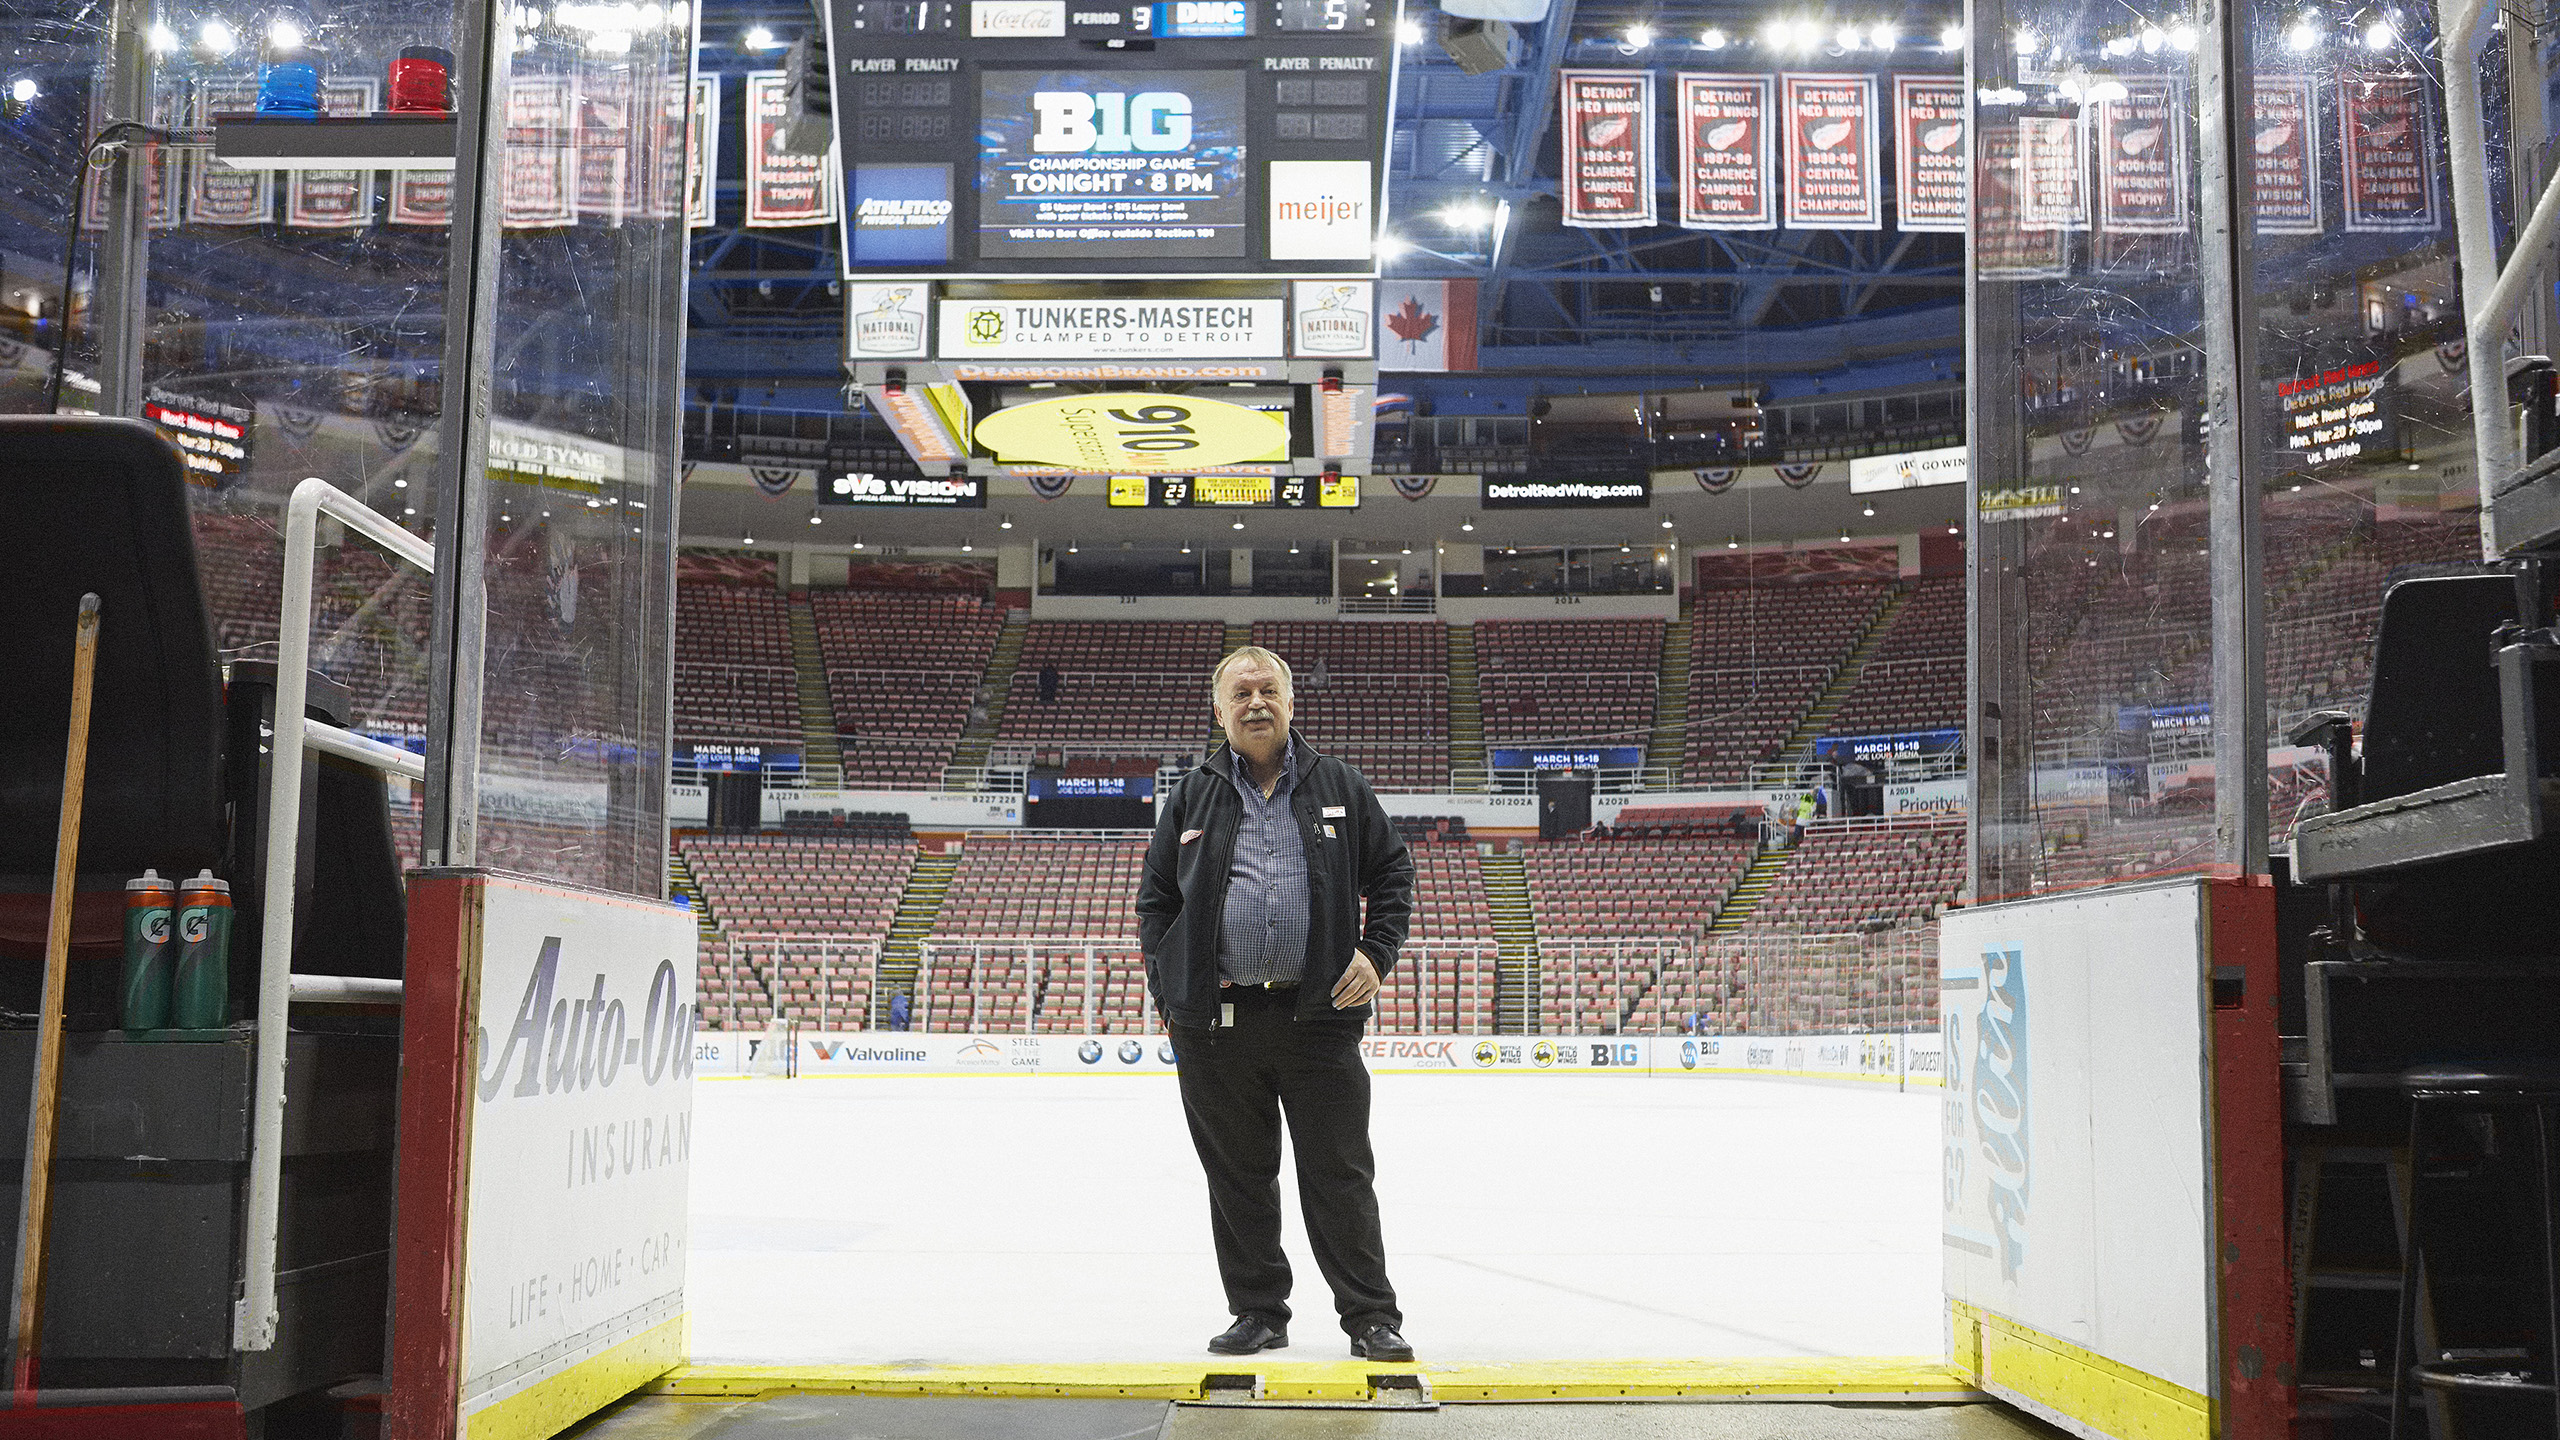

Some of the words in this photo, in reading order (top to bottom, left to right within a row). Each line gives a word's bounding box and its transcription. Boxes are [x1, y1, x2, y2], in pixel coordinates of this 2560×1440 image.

[1073, 12, 1120, 25] PERIOD
[1135, 7, 1150, 31] 3
[1177, 2, 1244, 24] DMC
[1326, 0, 1345, 30] 5
[851, 58, 896, 72] PLAYER
[905, 58, 959, 72] PENALTY
[1264, 57, 1309, 70] PLAYER
[1320, 57, 1374, 70] PENALTY
[1581, 87, 1635, 98] DETROIT
[1699, 91, 1752, 103] DETROIT
[1804, 90, 1857, 103] DETROIT
[1605, 101, 1641, 113] WINGS
[1694, 105, 1719, 118] RED
[1722, 105, 1759, 118] WINGS
[1799, 105, 1823, 117] RED
[1826, 105, 1863, 118] WINGS
[1911, 107, 1936, 119] RED
[1029, 158, 1147, 171] CHAMPIONSHIP
[1149, 158, 1196, 171] GAME
[1582, 166, 1637, 177] CLARENCE
[1697, 168, 1757, 180] CLARENCE
[1805, 168, 1858, 181] CENTRAL
[1011, 173, 1128, 192] TONIGHT
[1150, 173, 1168, 192] 8
[1175, 173, 1213, 192] PM
[1582, 181, 1636, 193] CAMPBELL
[770, 188, 814, 200] TROPHY
[1698, 183, 1757, 196] CAMPBELL
[1805, 184, 1860, 196] DIVISION
[1595, 197, 1624, 208] BOWL
[1711, 199, 1744, 211] BOWL
[2121, 192, 2164, 205] TROPHY
[1053, 203, 1082, 213] Upper
[1083, 203, 1107, 211] Bowl
[1132, 203, 1160, 211] Lower
[1161, 202, 1185, 211] Bowl
[1278, 194, 1364, 227] meijer
[1799, 199, 1867, 212] CHAMPIONS
[1058, 213, 1080, 221] your
[1125, 213, 1161, 221] today's
[1161, 213, 1188, 221] game
[1009, 229, 1034, 238] Visit
[1036, 229, 1054, 238] the
[1056, 229, 1078, 238] Box
[1079, 229, 1111, 239] Office
[1112, 229, 1153, 238] outside
[1154, 229, 1196, 238] Section
[1196, 229, 1215, 238] 101
[1016, 307, 1253, 328] TUNKERS-MASTECH
[863, 321, 915, 334] NATIONAL
[1308, 320, 1360, 333] NATIONAL
[1016, 332, 1112, 342] CLAMPED
[1127, 332, 1150, 342] TO
[1164, 332, 1253, 342] DETROIT
[2284, 388, 2327, 411] Detroit
[2329, 382, 2351, 400] Red
[2295, 411, 2319, 429] Next
[2321, 408, 2347, 423] Home
[2349, 401, 2375, 417] Game
[2290, 434, 2311, 449] Mon.
[543, 445, 605, 467] TYME
[2325, 441, 2361, 461] Buffalo
[1922, 460, 1939, 471] GO
[890, 480, 977, 496] VISION
[1165, 484, 1187, 498] 23
[1282, 485, 1304, 499] 24
[1489, 483, 1642, 499] DetroitRedWings.com
[367, 720, 404, 731] MARCH
[2152, 719, 2182, 729] MARCH
[693, 745, 731, 754] MARCH
[1854, 743, 1891, 754] MARCH
[694, 754, 709, 762] JOE
[710, 755, 732, 763] LOUIS
[734, 755, 760, 763] ARENA
[1533, 755, 1571, 763] MARCH
[1871, 752, 1893, 760] LOUIS
[1894, 751, 1919, 759] ARENA
[1057, 778, 1095, 787] MARCH
[1900, 794, 1967, 813] PriorityH
[141, 908, 171, 944] G
[180, 908, 209, 944] G
[1012, 1038, 1040, 1046] STEEL
[695, 1042, 720, 1060] ate
[846, 1047, 926, 1062] Valvoline
[1361, 1041, 1386, 1058] RE
[1390, 1041, 1458, 1067] RACK
[1012, 1058, 1040, 1066] GAME
[1414, 1060, 1446, 1068] .com
[1945, 1100, 1964, 1139] FOR
[567, 1110, 691, 1189] INSURAN
[510, 1274, 548, 1329] LIFE
[572, 1247, 622, 1304] HOME
[641, 1231, 671, 1276] CAR
